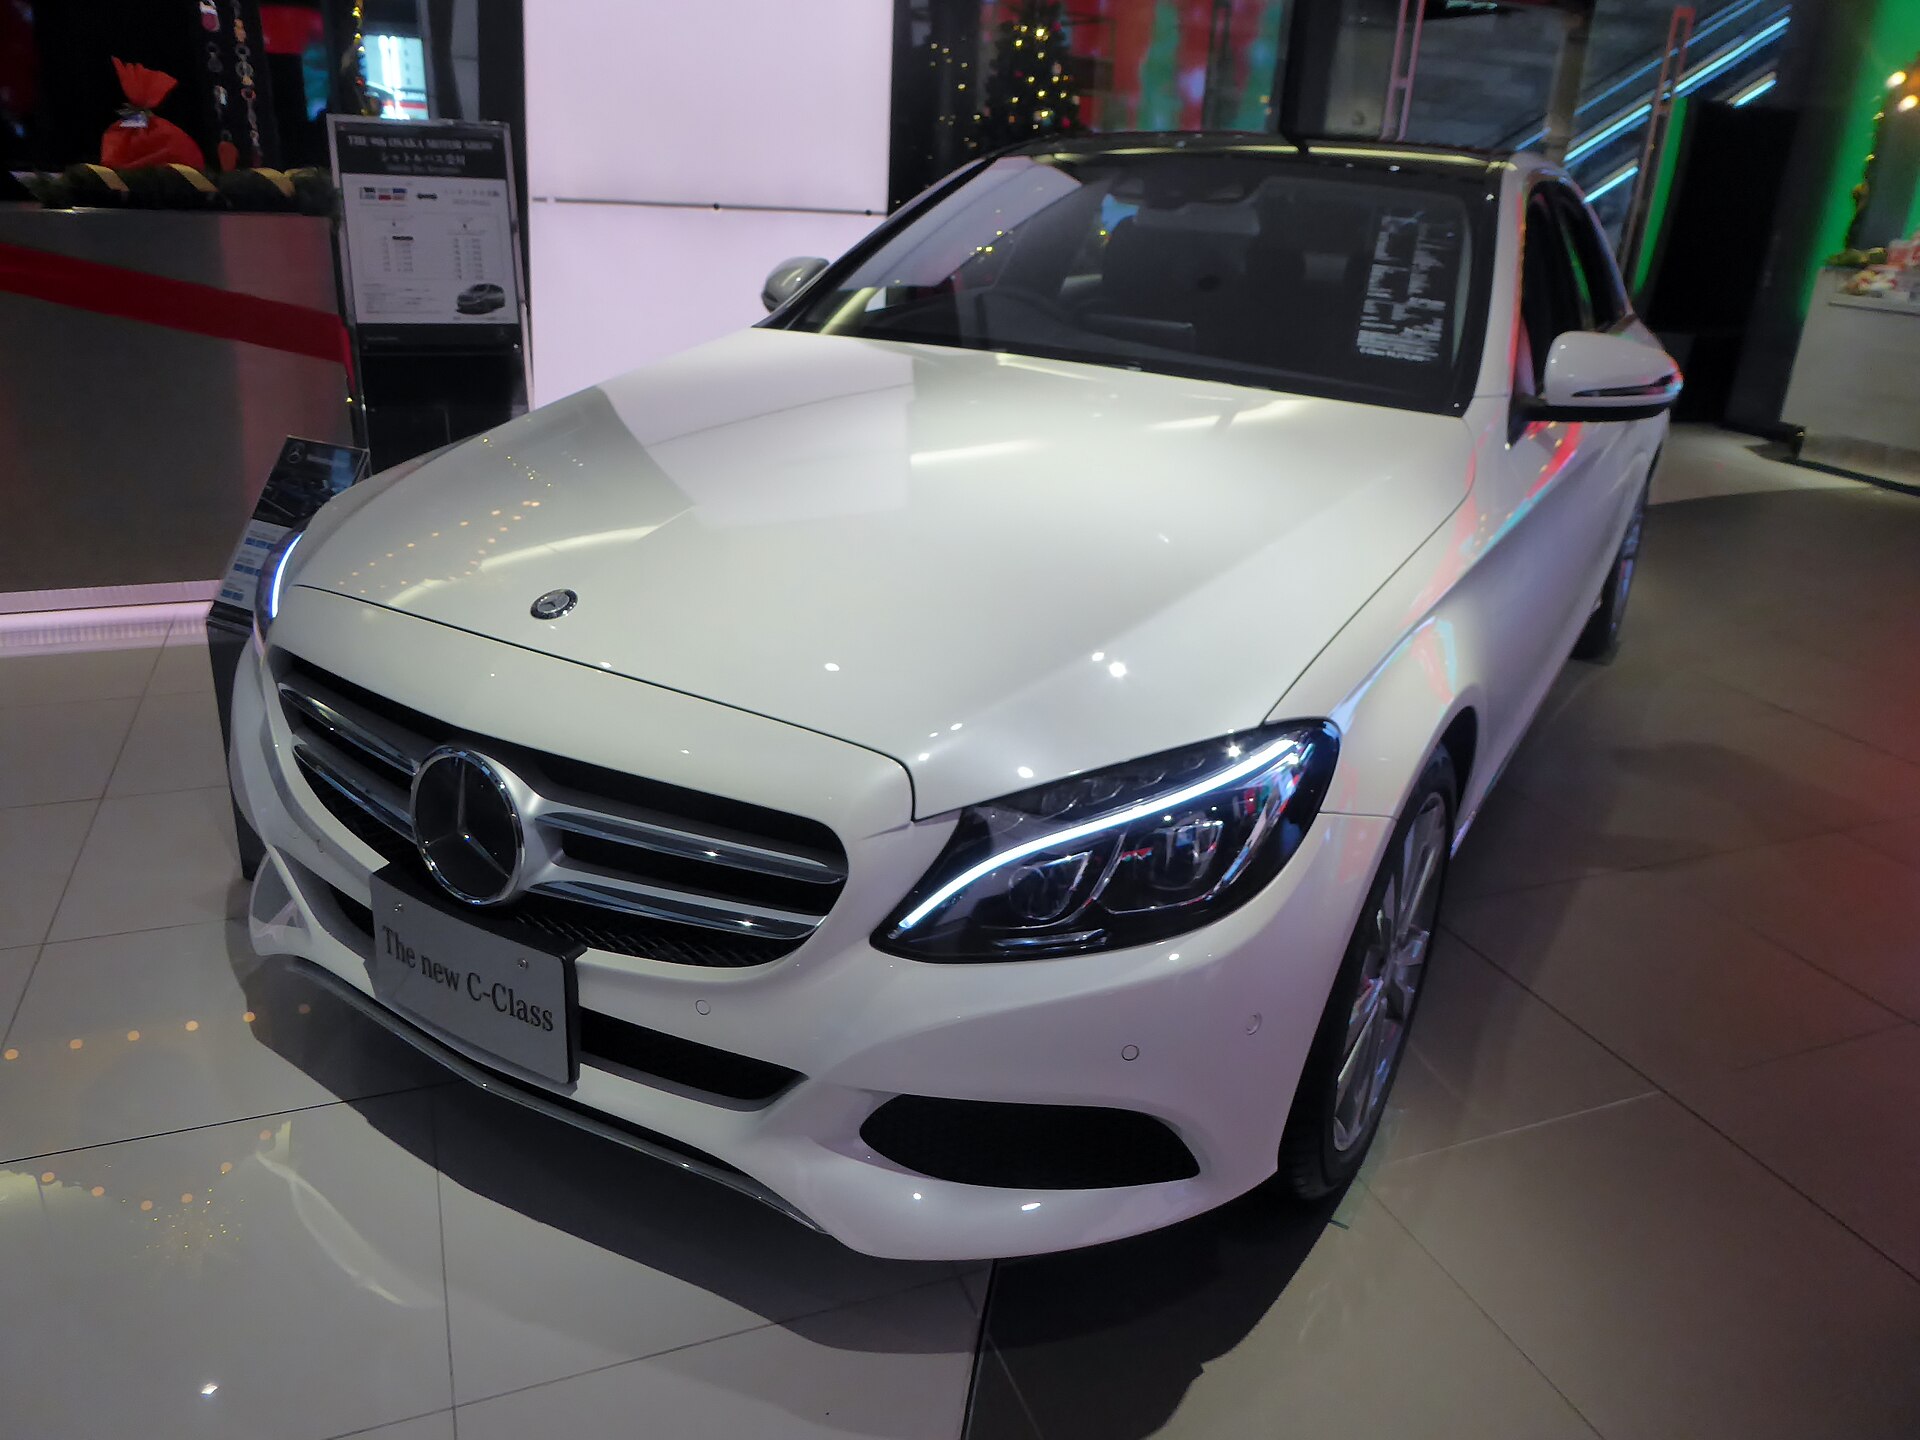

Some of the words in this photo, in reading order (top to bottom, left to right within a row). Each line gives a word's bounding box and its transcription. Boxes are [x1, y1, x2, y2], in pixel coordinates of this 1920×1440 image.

[382, 925, 416, 968] The
[421, 953, 460, 991] new
[467, 972, 554, 1031] C-Class
